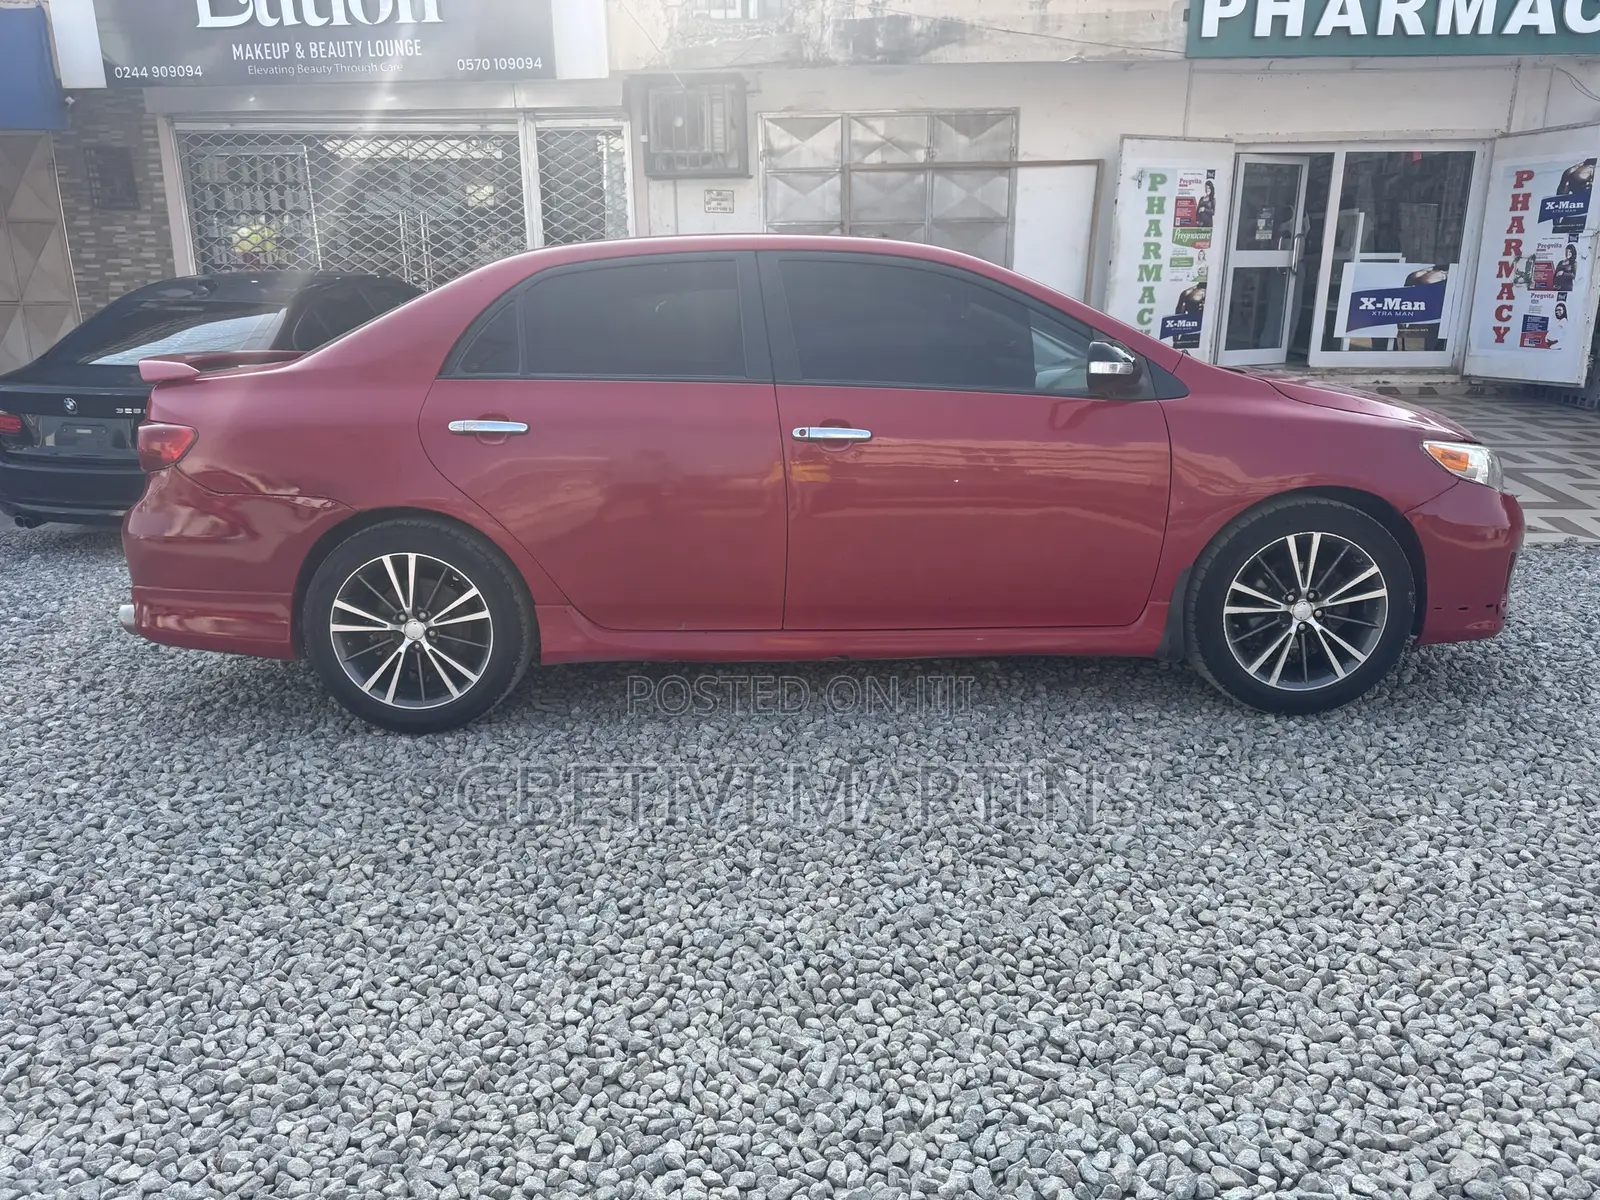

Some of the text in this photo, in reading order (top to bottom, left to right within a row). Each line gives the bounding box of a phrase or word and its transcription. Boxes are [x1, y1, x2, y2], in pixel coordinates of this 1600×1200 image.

[231, 39, 423, 61] MAKEUP & BEAUTY LOUNGE
[247, 61, 404, 76] Elevating Beauty Through Care
[457, 57, 543, 71] 0570 109094
[114, 65, 203, 79] 0244 909094
[1545, 200, 1584, 210] X-Man
[1136, 173, 1168, 334] PHARMAC
[1492, 169, 1535, 344] PHARMACY
[1358, 297, 1426, 311] X-Man
[1165, 319, 1198, 328] X-Man
